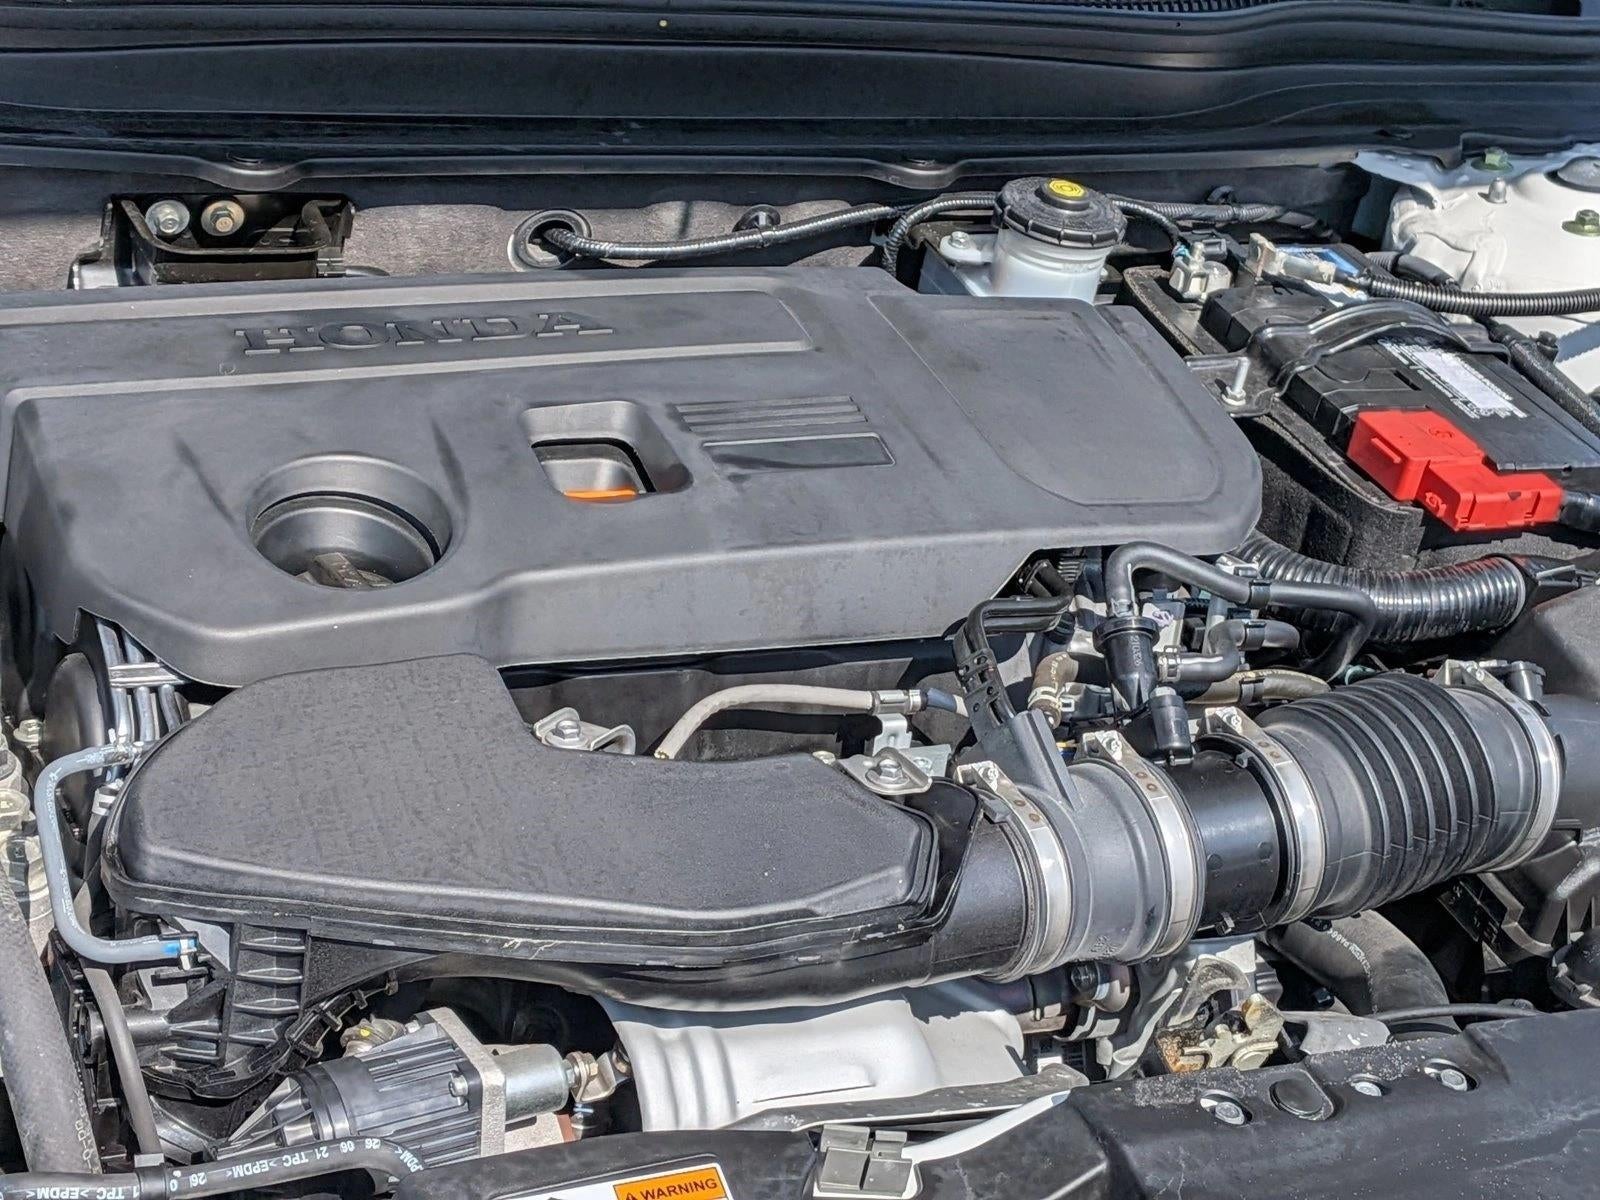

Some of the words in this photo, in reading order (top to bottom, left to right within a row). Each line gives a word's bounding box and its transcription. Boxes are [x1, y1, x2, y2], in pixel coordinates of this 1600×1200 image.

[234, 313, 614, 355] HONDA
[340, 1140, 355, 1153] 06
[365, 1138, 381, 1149] 26
[281, 1151, 309, 1167] TPC
[315, 1146, 329, 1160] 21
[96, 1187, 125, 1200] TPC
[640, 1178, 718, 1200] WARNING
